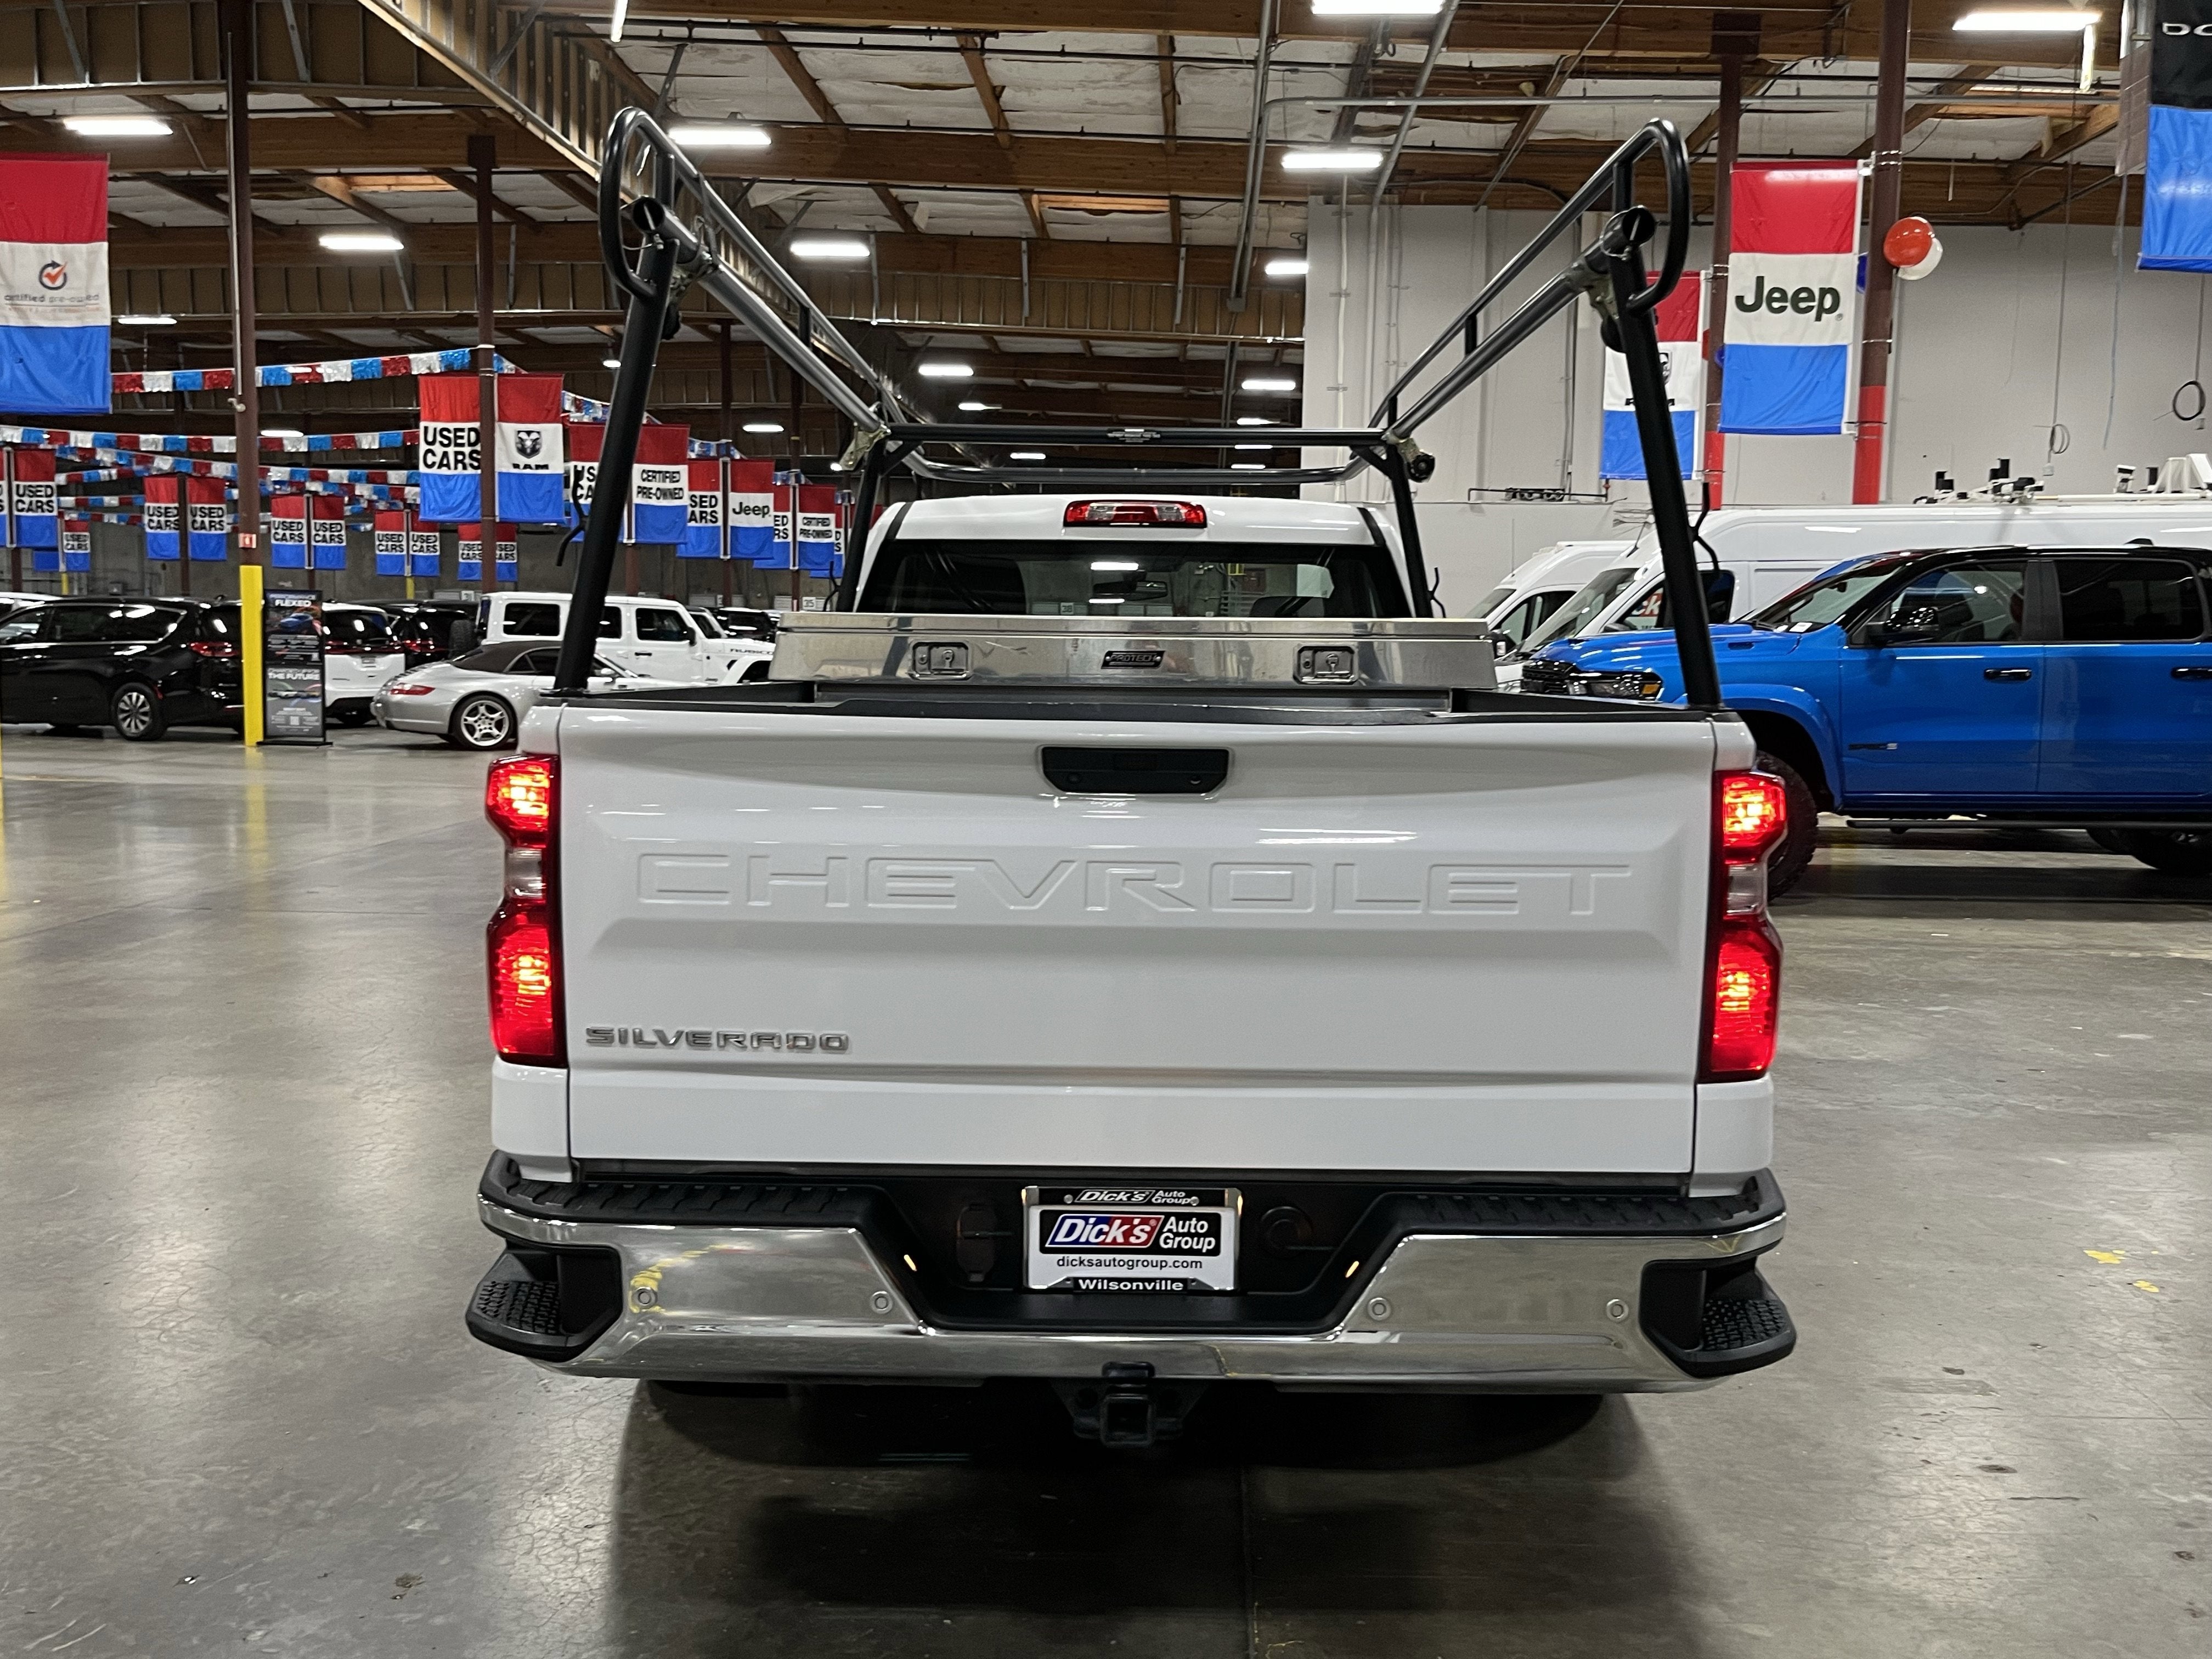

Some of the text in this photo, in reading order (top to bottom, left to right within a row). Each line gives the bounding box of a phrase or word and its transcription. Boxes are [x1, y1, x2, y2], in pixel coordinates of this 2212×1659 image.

[1735, 275, 1841, 322] Jeep
[424, 426, 481, 448] USED
[423, 448, 481, 470] CARS
[641, 469, 680, 483] CERTIFIED
[15, 484, 54, 498] USED
[636, 486, 684, 500] PRE-OWNED
[15, 499, 54, 513] CARS
[689, 494, 718, 509] SED
[147, 505, 179, 517] USED
[190, 506, 224, 518] USED
[732, 501, 770, 518] Jeep
[688, 510, 719, 524] ARS
[774, 515, 789, 527] ED
[191, 519, 225, 531] CARS
[273, 521, 303, 531] USED
[314, 522, 343, 533] USED
[273, 532, 304, 543] CARS
[313, 533, 344, 544] CARS
[377, 533, 404, 543] USED
[411, 534, 438, 544] USED
[774, 528, 789, 539] RS
[377, 543, 404, 553] CARS
[411, 544, 438, 554] CARS
[636, 853, 1634, 917] CHEVROLET
[585, 1026, 849, 1051] SILVERADO
[1079, 1190, 1147, 1201] Dick's
[1151, 1197, 1191, 1205] Group
[1054, 1216, 1209, 1244] Dick's Auto
[1159, 1233, 1216, 1252] Group
[1057, 1256, 1203, 1270] dicksautogroup.com
[1078, 1279, 1184, 1291] Wilsonville
